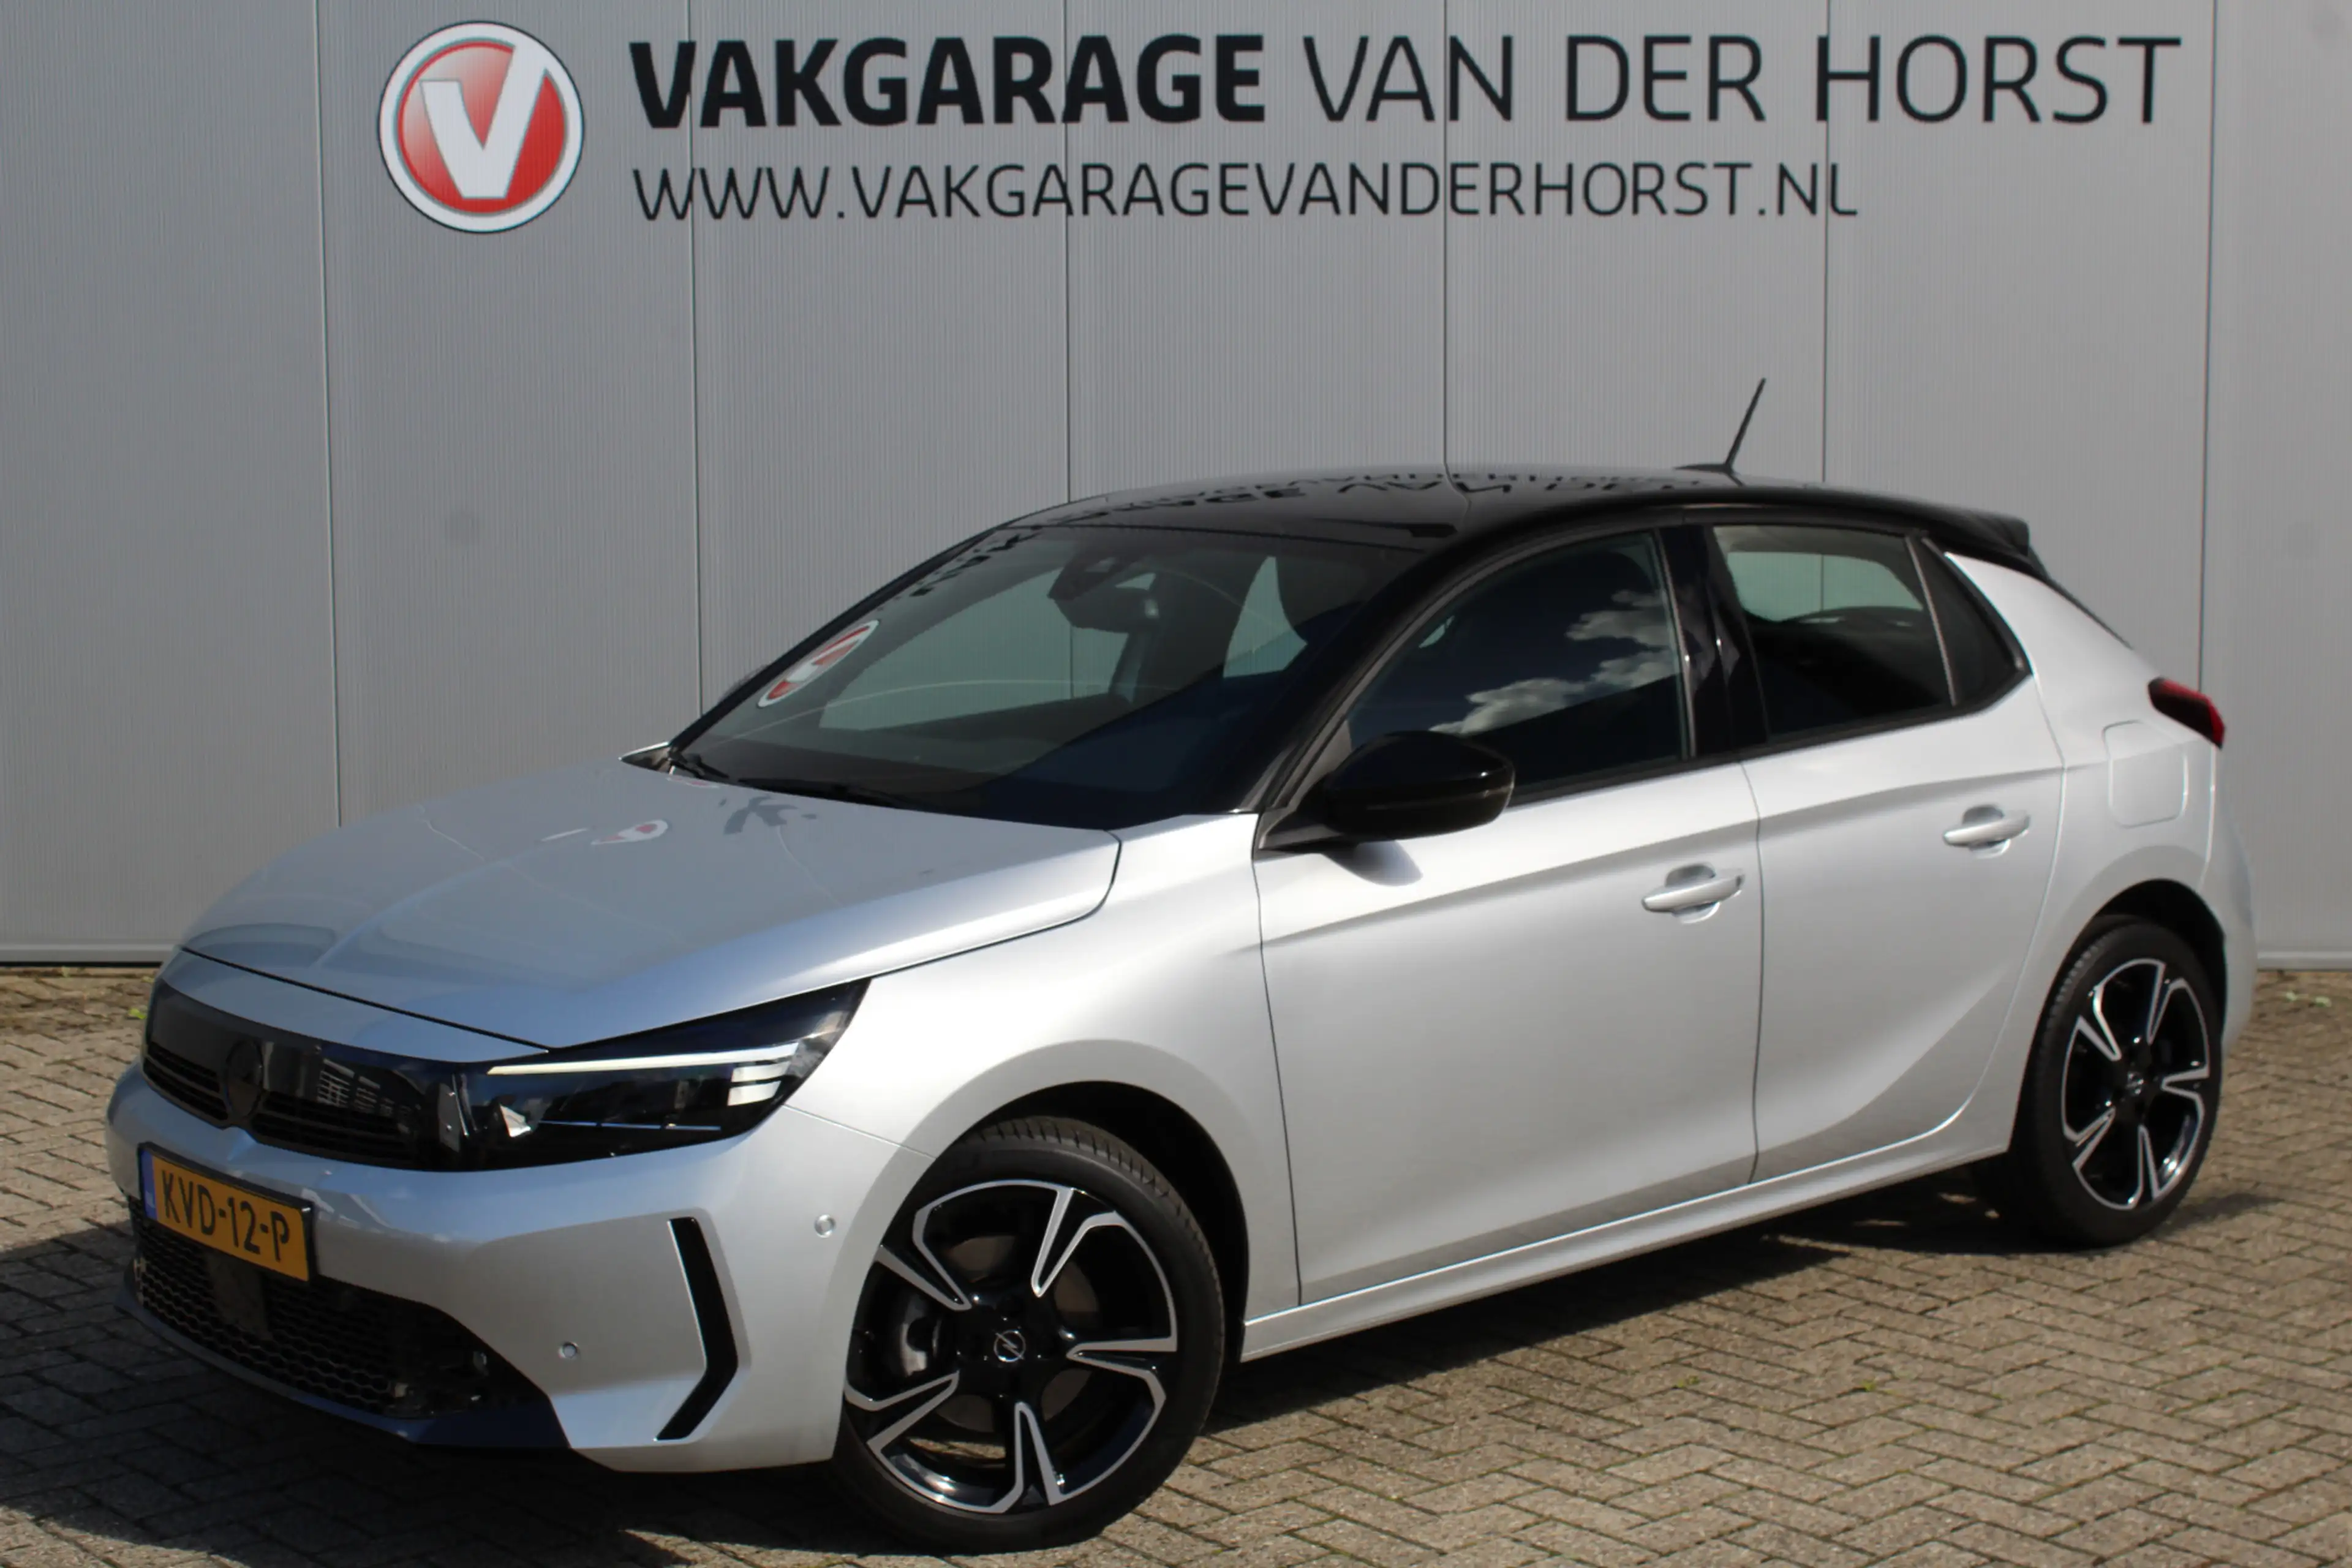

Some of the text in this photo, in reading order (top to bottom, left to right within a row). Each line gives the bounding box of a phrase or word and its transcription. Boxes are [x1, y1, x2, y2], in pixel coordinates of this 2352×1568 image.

[629, 34, 2182, 129] VAKGARAGE VAN DER HORST
[632, 162, 1858, 221] WWW.VAKGARAGEVANDERHORST.NL
[162, 1169, 290, 1263] KVD-12-P
